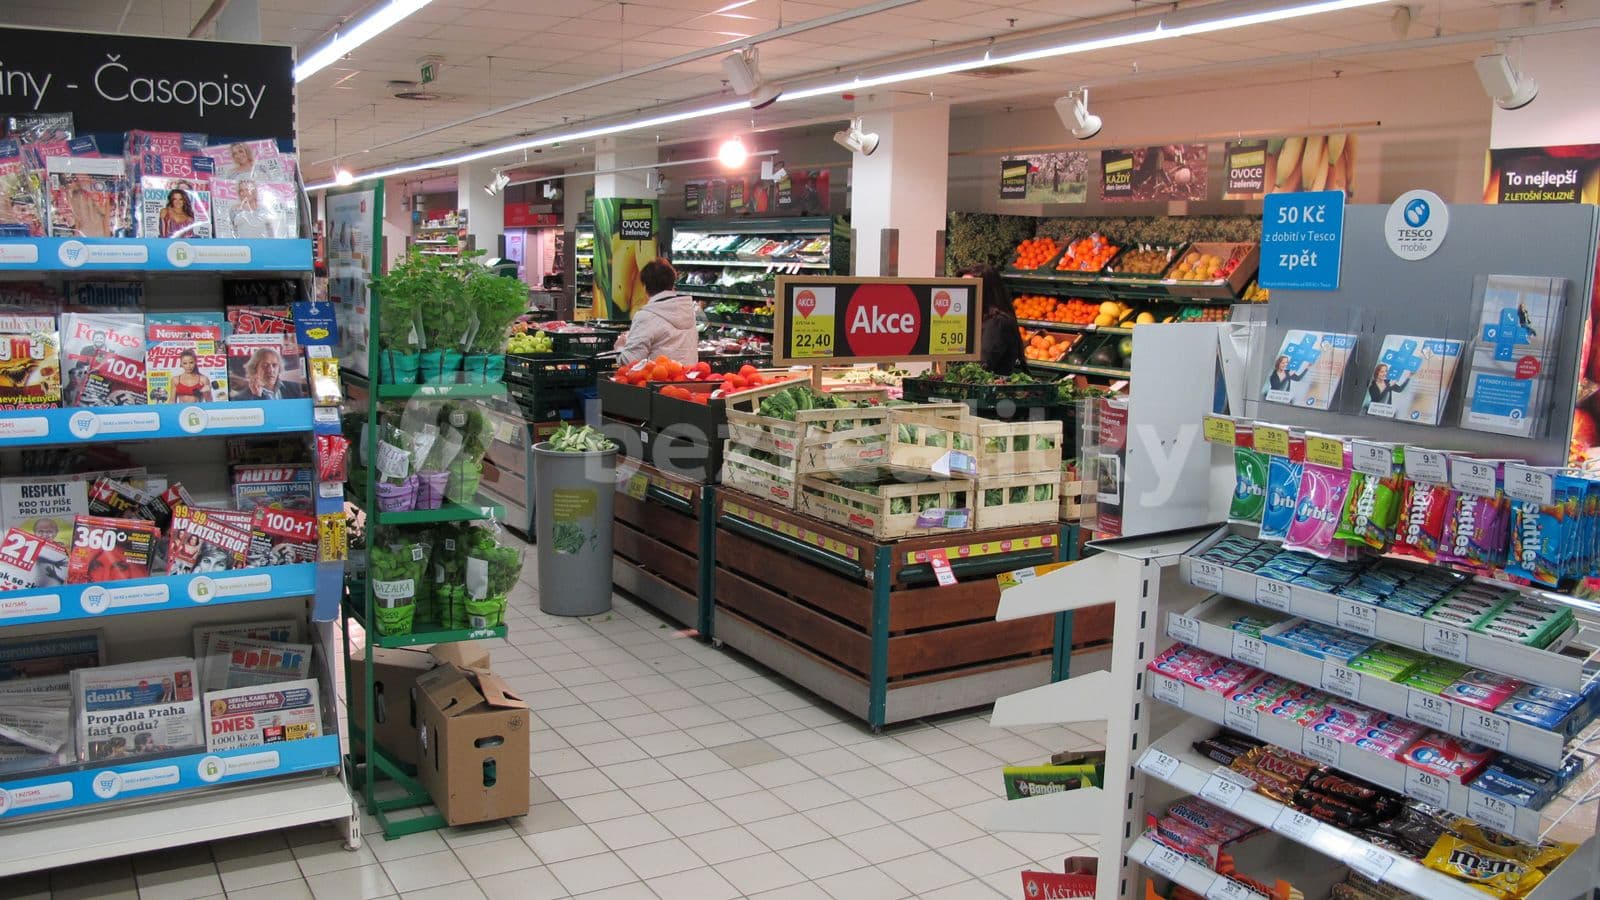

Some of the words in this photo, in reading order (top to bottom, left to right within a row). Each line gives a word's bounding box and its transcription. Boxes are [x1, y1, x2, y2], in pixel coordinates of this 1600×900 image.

[95, 54, 267, 119] Časopisy
[1233, 179, 1262, 189] zeleniny
[1506, 172, 1522, 185] To
[1525, 170, 1578, 188] nejlepší
[1504, 193, 1511, 201] Z
[1511, 190, 1542, 201] LETOŠNÍ
[1542, 189, 1575, 200] SKLIZNĚ
[1278, 206, 1298, 224] 50
[1303, 205, 1326, 223] Kč
[1272, 231, 1300, 242] dobití
[1308, 231, 1336, 241] Tesco
[1398, 229, 1433, 238] TESCO
[1400, 242, 1428, 252] mobile
[1279, 250, 1318, 270] zpět
[797, 298, 815, 307] AKCE
[934, 298, 949, 307] AKCE
[850, 305, 915, 334] Akce
[796, 334, 831, 348] 22,40
[940, 332, 964, 345] 5,90
[21, 484, 67, 498] RESPEKT
[40, 506, 71, 514] PUTINA
[266, 513, 313, 536] 100+1
[1521, 502, 1541, 571] Skittles
[87, 711, 145, 725] Propadla
[149, 706, 186, 718] Praha
[88, 725, 113, 737] fast
[116, 720, 159, 734] foodu?
[211, 717, 255, 735] DNES
